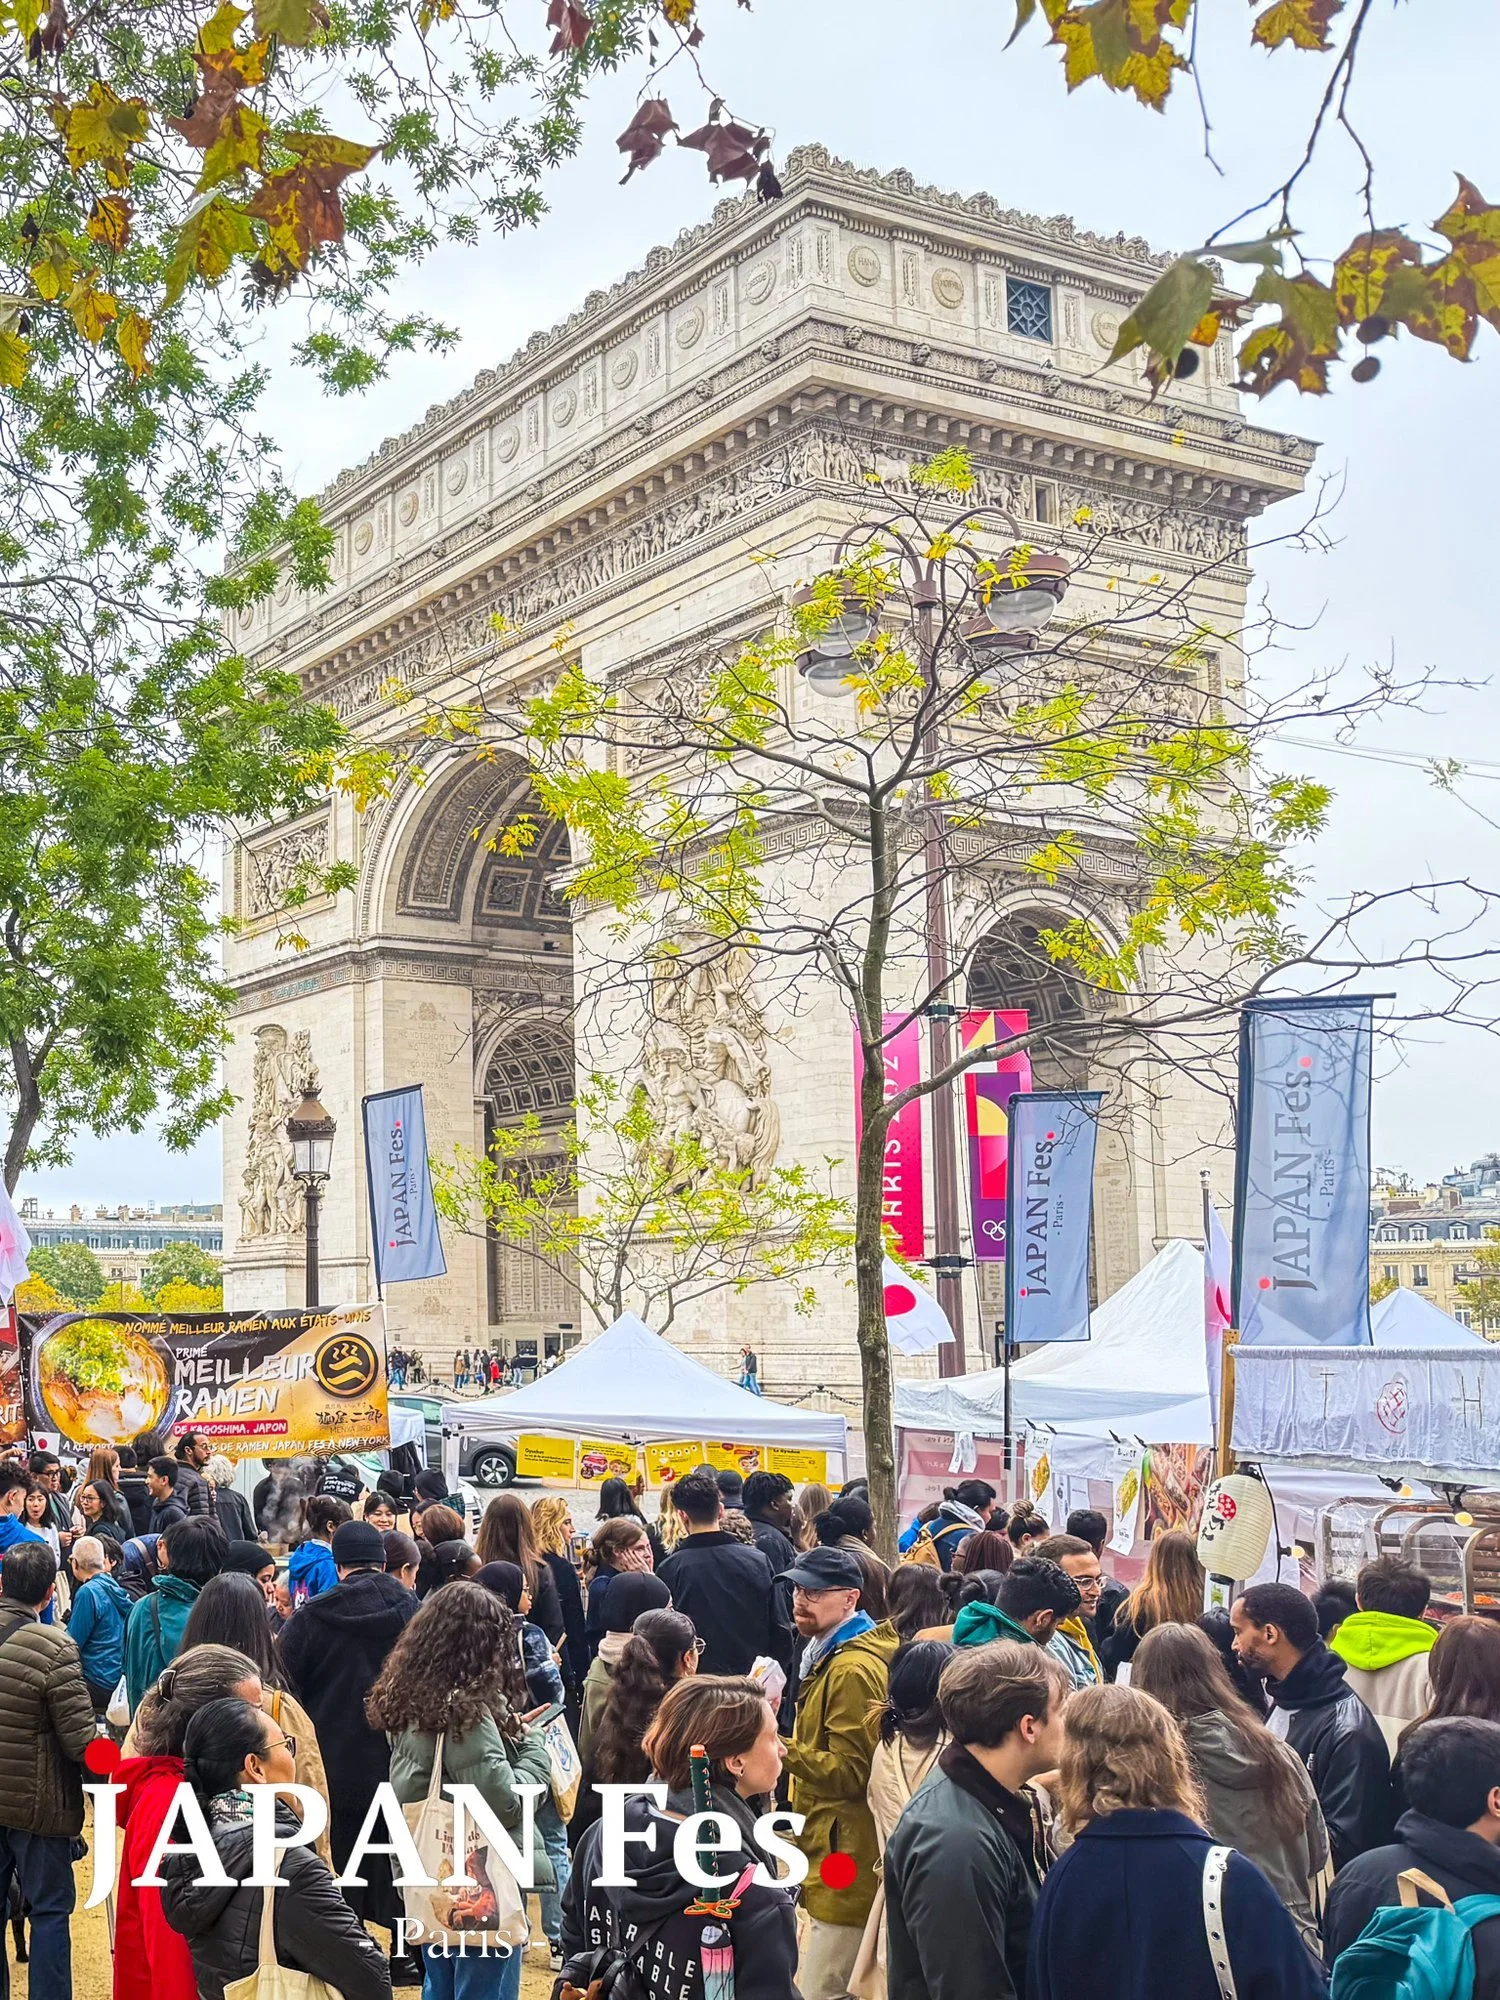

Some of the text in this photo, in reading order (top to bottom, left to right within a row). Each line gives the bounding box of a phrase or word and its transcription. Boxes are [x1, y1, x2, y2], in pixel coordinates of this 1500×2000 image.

[409, 1171, 419, 1195] Paris
[1319, 1158, 1336, 1198] Paris
[389, 1171, 417, 1248] JAPAN
[1052, 1200, 1064, 1229] Paris
[1272, 1149, 1318, 1292] JAPAN
[1025, 1197, 1051, 1297] JAPAN
[124, 1310, 372, 1335] NOMMÉ MEILLEUR RAMEN AUX ÉTATS-UNIS
[174, 1352, 320, 1386] MEILLEUR
[175, 1387, 280, 1419] RAMEN
[174, 1425, 188, 1435] DE
[253, 1422, 287, 1434] JAPON
[221, 1441, 232, 1451] DE
[236, 1441, 270, 1451] RAMEN
[273, 1439, 305, 1451] JAPAN
[308, 1439, 326, 1450] FES
[338, 1436, 359, 1448] NEW
[359, 1435, 389, 1446] YORK
